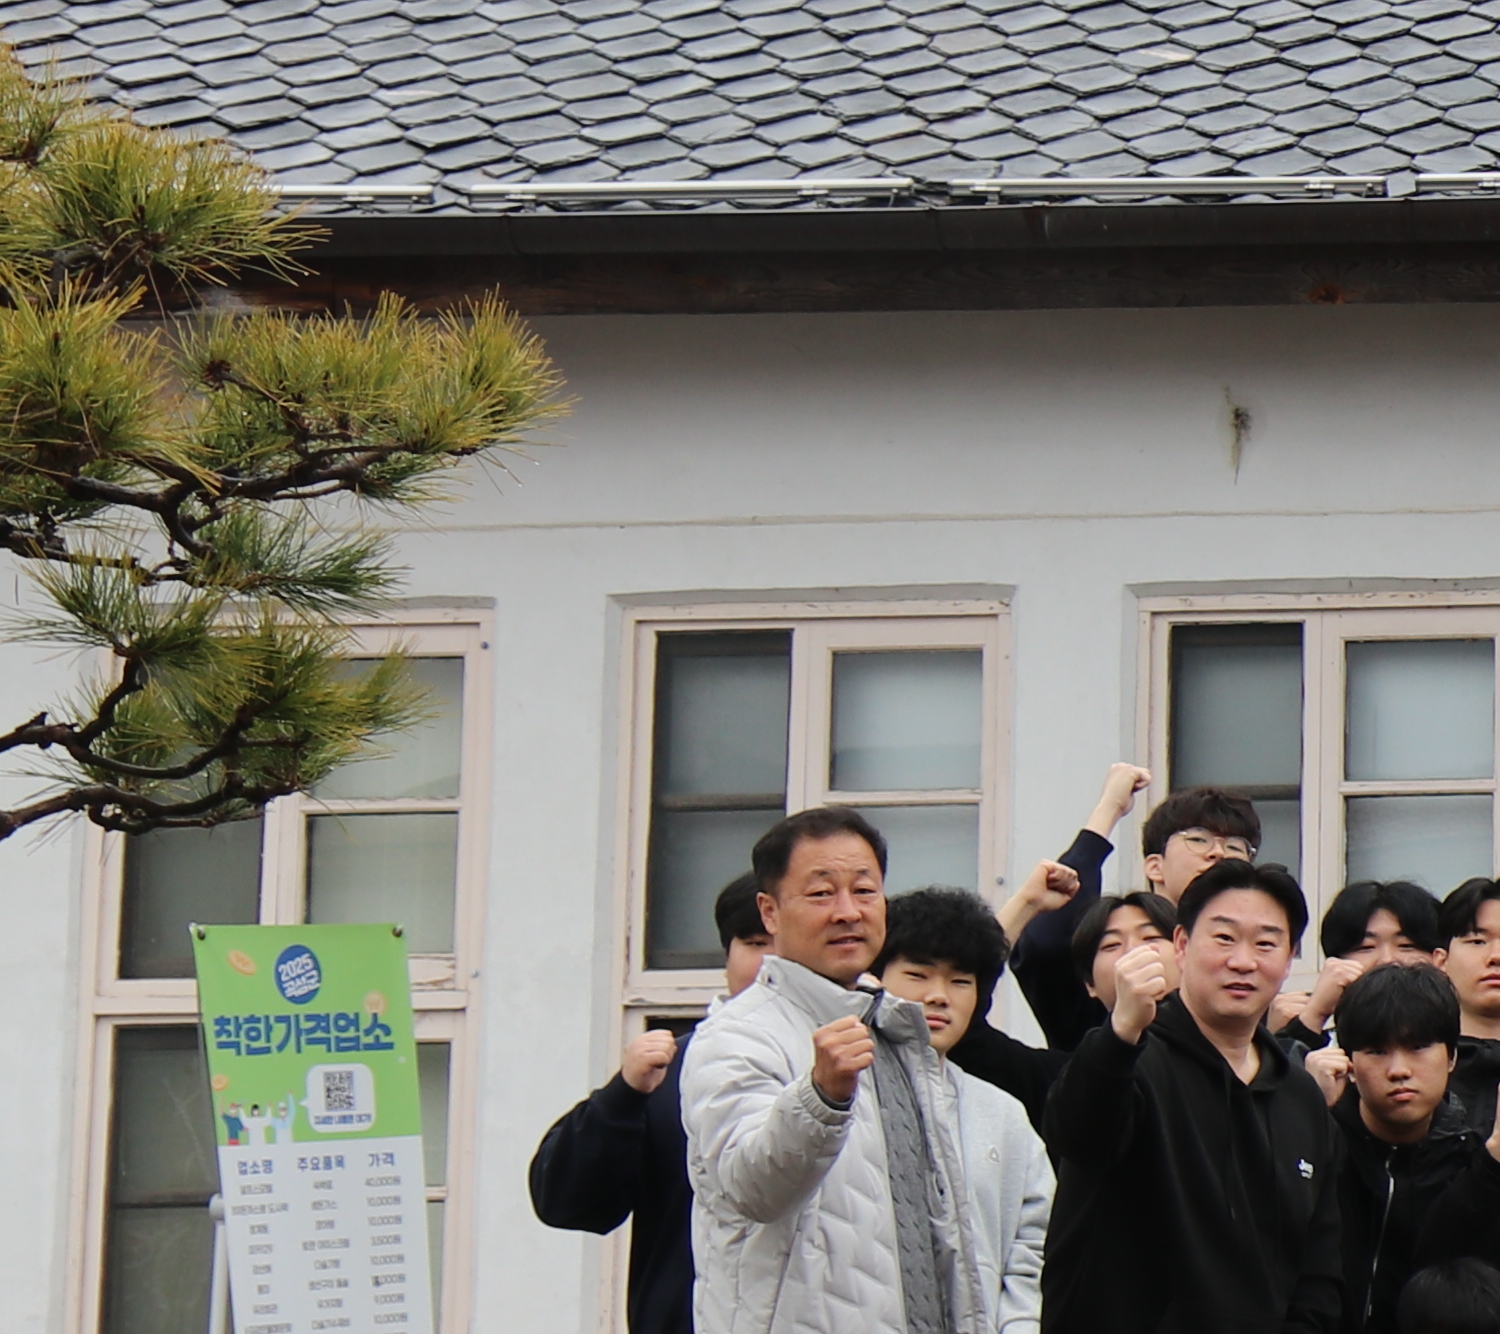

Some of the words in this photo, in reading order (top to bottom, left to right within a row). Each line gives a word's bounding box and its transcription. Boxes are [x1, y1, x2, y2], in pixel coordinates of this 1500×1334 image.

[278, 953, 314, 982] 2025
[282, 970, 321, 997] 곡성군
[213, 1012, 394, 1056] 착한가격업소
[237, 1159, 274, 1175] 업소명
[296, 1155, 346, 1173] 주요품목
[368, 1152, 396, 1167] 가격
